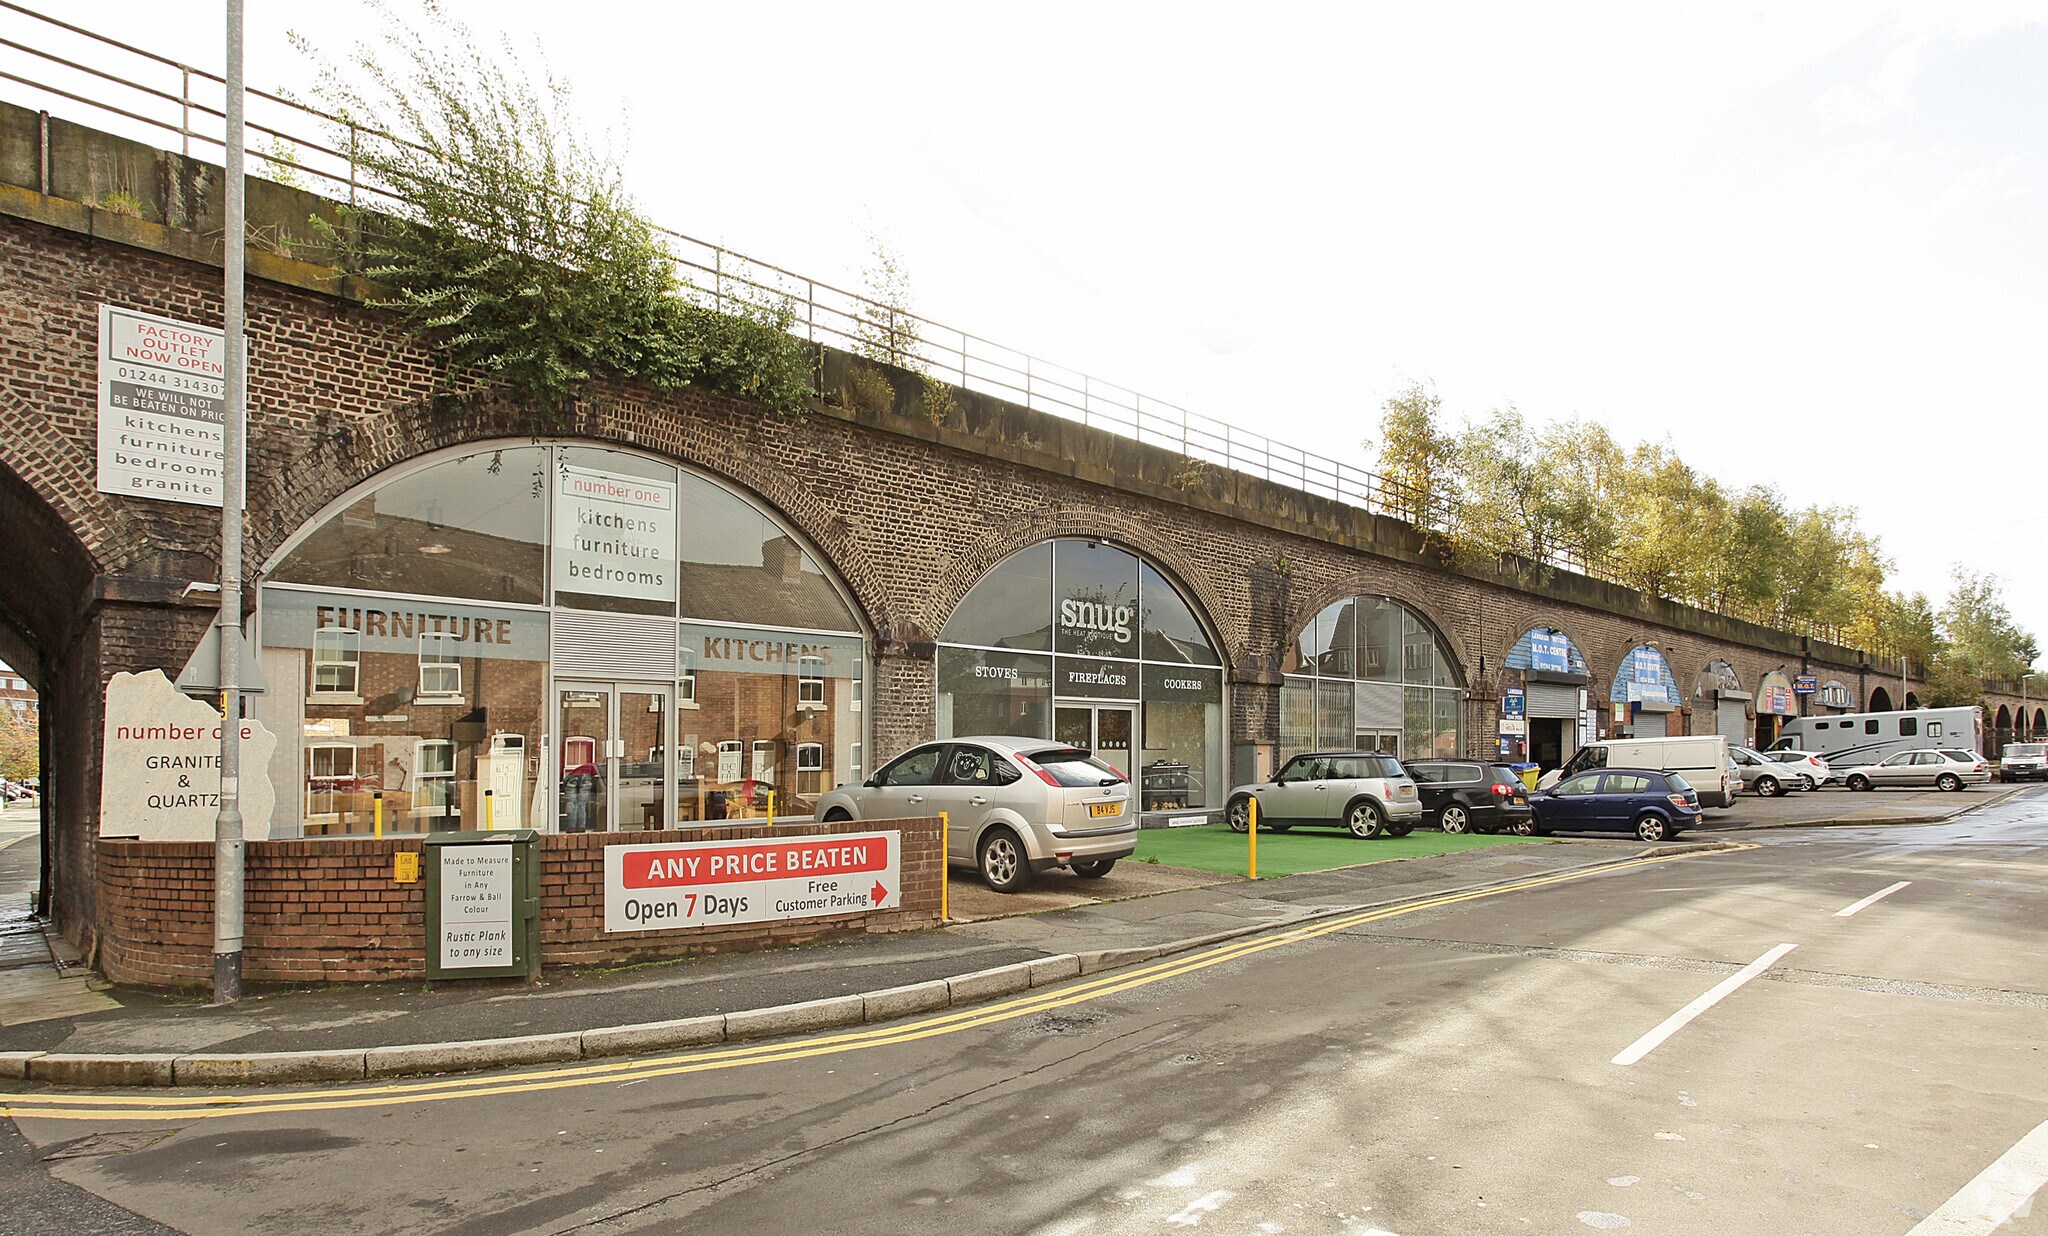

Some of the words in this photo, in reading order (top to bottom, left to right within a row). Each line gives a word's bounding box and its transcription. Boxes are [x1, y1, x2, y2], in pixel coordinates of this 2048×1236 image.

[138, 324, 213, 348] FACTORY
[143, 338, 208, 358] OUTLET
[126, 346, 171, 363] NOW
[178, 356, 222, 374] OPEN
[118, 367, 166, 384] 01244
[114, 394, 128, 406] BE
[133, 398, 176, 413] BEATEN
[180, 406, 197, 416] ON
[201, 410, 224, 422] PRIC
[136, 388, 154, 400] WE
[158, 391, 186, 405] WILL
[190, 397, 212, 409] NOT
[125, 416, 220, 441] kitchens
[119, 434, 224, 460] furniture
[132, 477, 213, 495] granite
[574, 479, 630, 498] number
[635, 490, 660, 502] one
[578, 507, 656, 533] kitchens
[573, 534, 659, 560] furniture
[569, 560, 663, 585] bedrooms
[316, 606, 512, 645] FURNITURE
[1061, 599, 1134, 643] snug
[1061, 628, 1071, 636] THE
[704, 636, 833, 666] KITCHENS
[975, 666, 1018, 679] STOVES
[1069, 672, 1126, 686] FIREPLACES
[1164, 679, 1202, 690] COOKERS
[117, 723, 205, 740] number
[212, 726, 251, 740] oe
[146, 756, 221, 769] GRANITE
[178, 775, 190, 788] &
[147, 794, 219, 809] QUARTZ
[648, 857, 701, 880] ANY
[710, 852, 777, 876] PRICE
[786, 845, 867, 871] BEATEN
[474, 882, 488, 890] Any
[808, 880, 838, 893] Free
[624, 898, 678, 924] Open
[684, 893, 697, 917] 7
[704, 894, 748, 919] Days
[775, 896, 828, 912] Customer
[830, 892, 867, 909] Parking
[447, 931, 475, 942] Rustic
[479, 930, 506, 941] Plank
[450, 948, 459, 957] to
[464, 948, 480, 958] any
[485, 946, 502, 956] size
